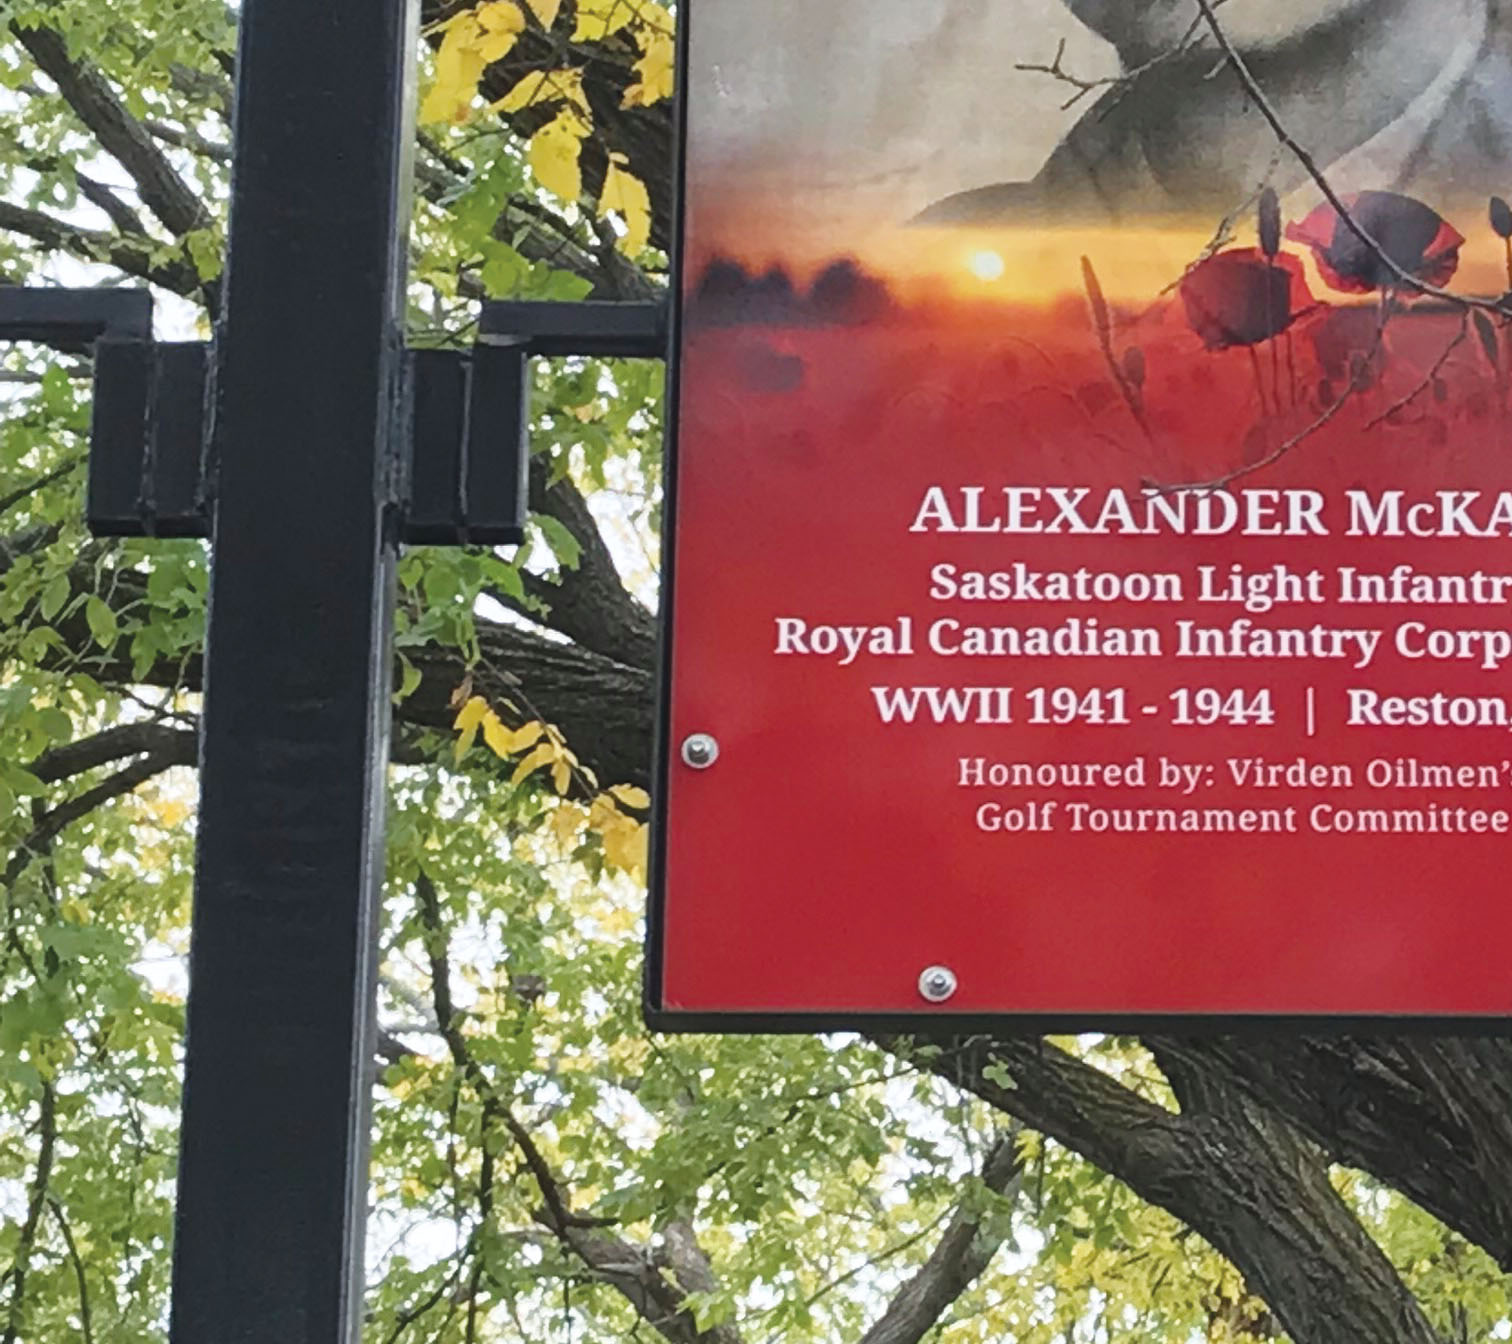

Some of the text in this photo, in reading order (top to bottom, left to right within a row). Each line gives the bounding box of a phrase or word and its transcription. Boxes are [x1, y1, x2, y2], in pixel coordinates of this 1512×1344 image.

[910, 487, 1328, 535] ALEXANDER
[931, 563, 1182, 600] Saskatoon
[1199, 565, 1324, 612] Light
[775, 617, 913, 664] Royal
[929, 618, 1161, 655] Canadian
[1177, 619, 1381, 668] Infantry
[871, 687, 1012, 723] WWII
[1026, 688, 1129, 723] 1941
[1170, 689, 1274, 724] 1944
[960, 758, 1144, 786] Honoured
[1160, 758, 1212, 793] by:
[1228, 759, 1352, 786] Virden
[977, 802, 1508, 832] Golf Tournament Committee
